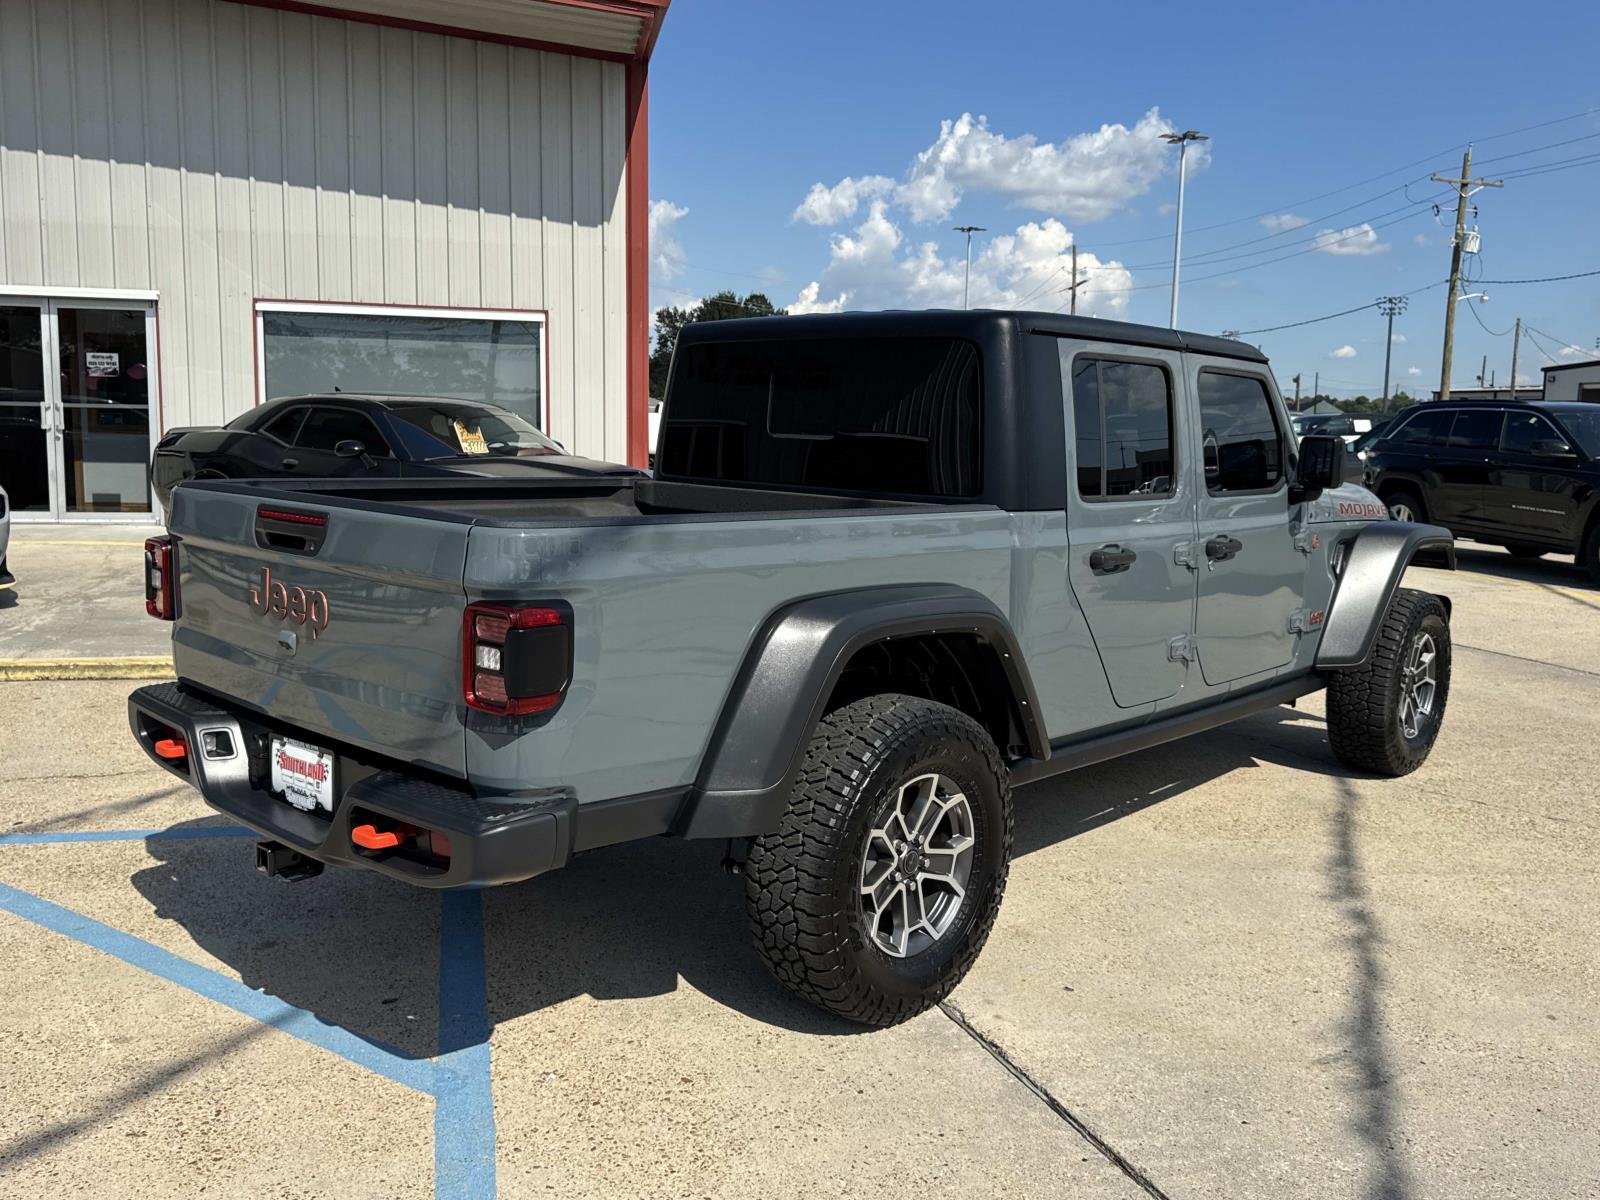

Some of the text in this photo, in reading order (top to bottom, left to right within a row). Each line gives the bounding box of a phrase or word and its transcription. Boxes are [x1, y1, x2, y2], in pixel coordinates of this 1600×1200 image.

[1338, 502, 1388, 517] MOJAVE
[250, 566, 328, 640] Jeep
[280, 750, 325, 782] SOUTHLAND
